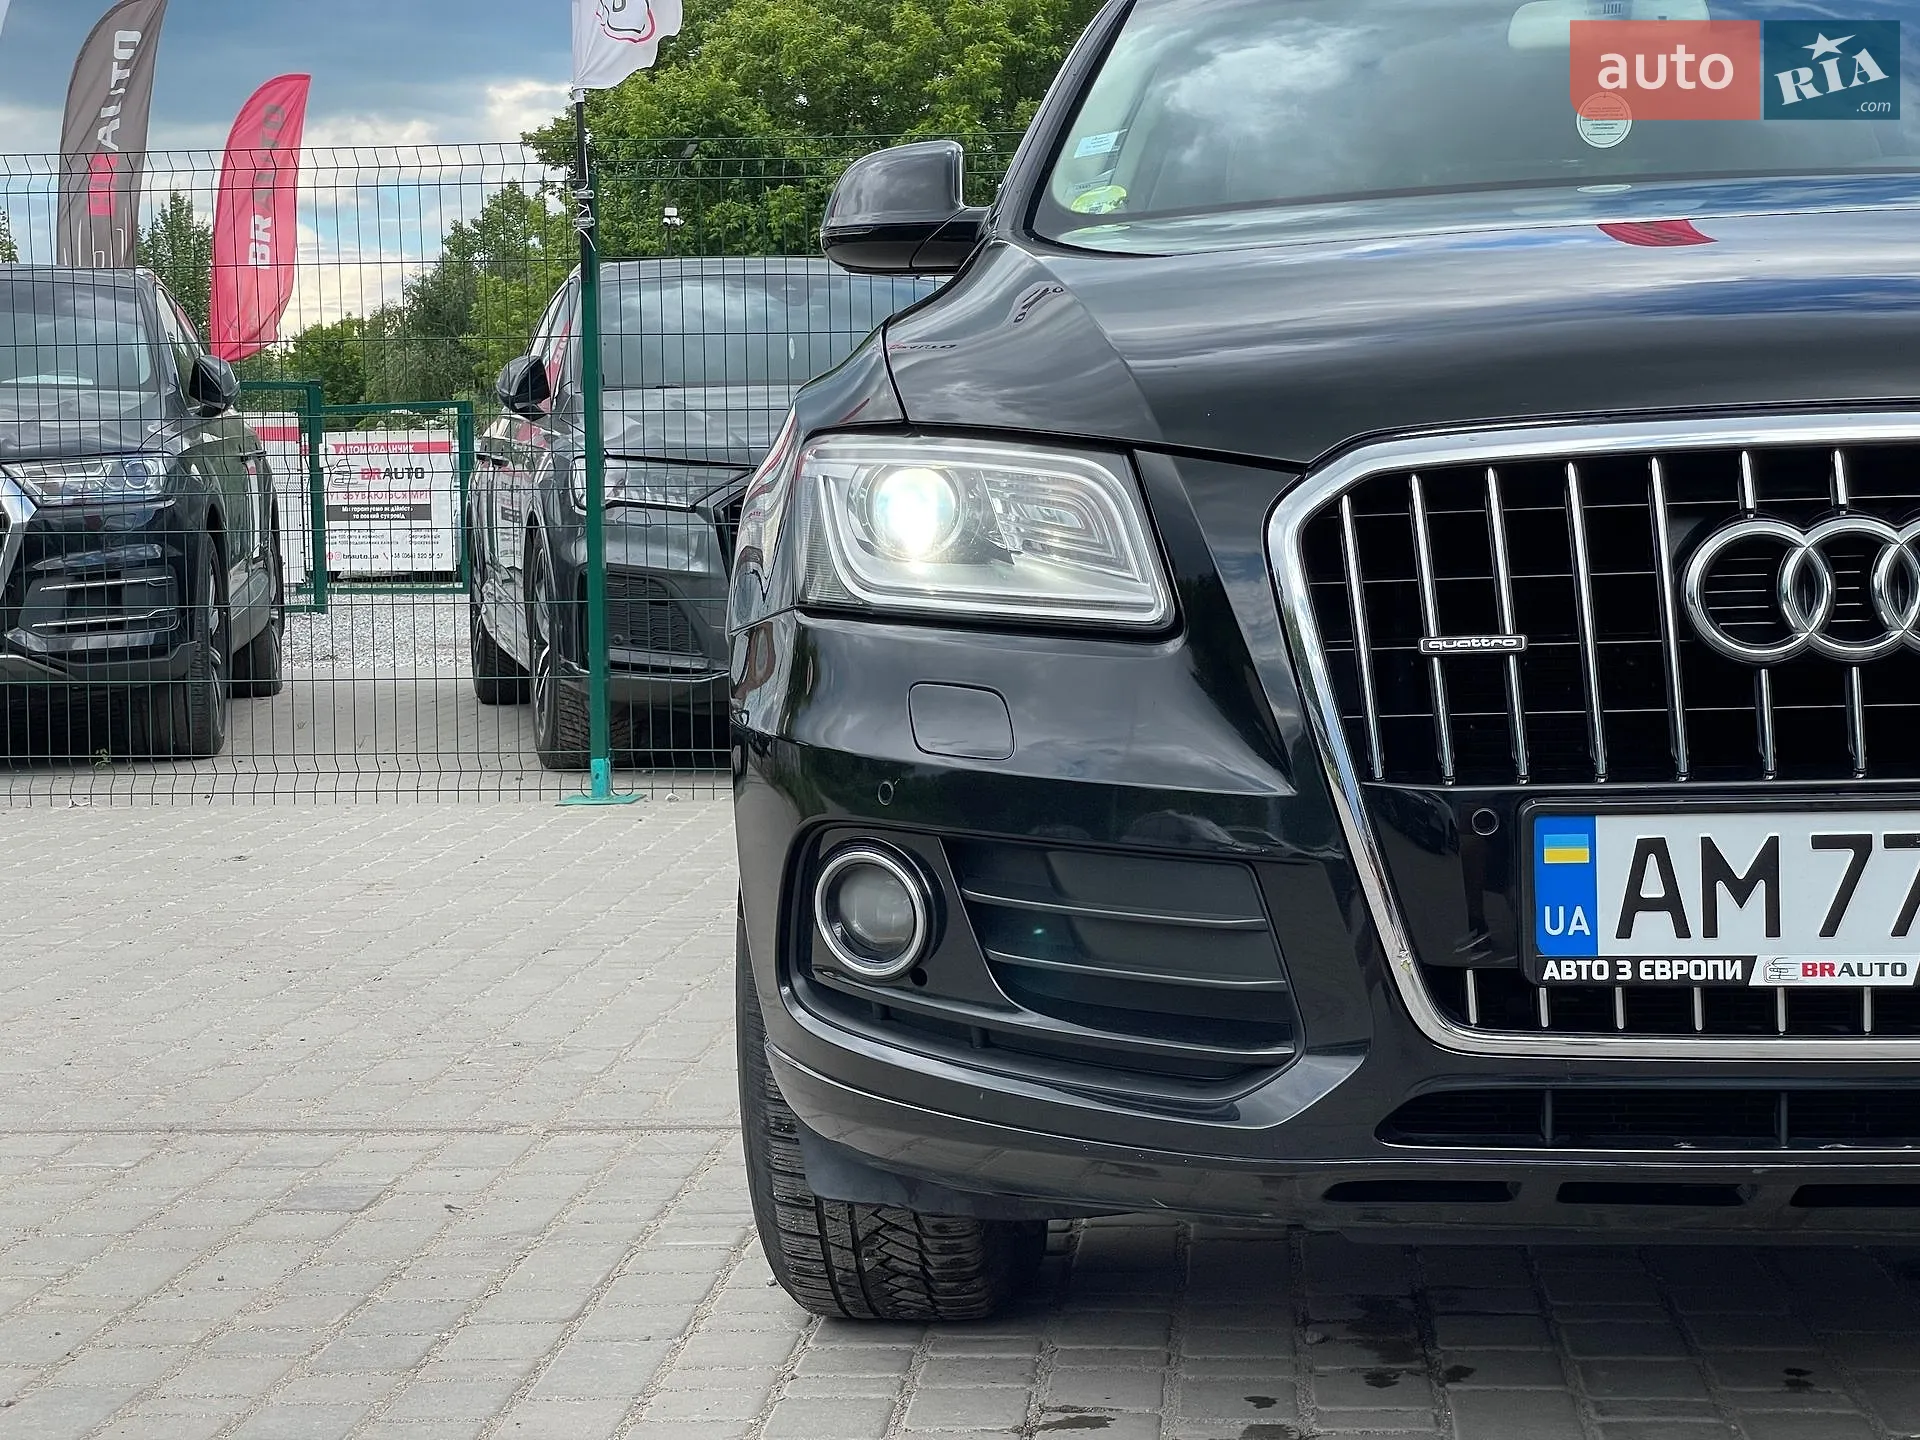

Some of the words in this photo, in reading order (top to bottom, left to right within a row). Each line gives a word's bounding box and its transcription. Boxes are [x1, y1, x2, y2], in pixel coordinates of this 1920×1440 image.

[360, 467, 425, 481] BRAUTO
[1428, 638, 1518, 651] quattro
[1543, 905, 1591, 936] UA
[1614, 834, 1782, 939] AM
[1543, 959, 1610, 981] АВТО
[1615, 959, 1633, 981] З
[1638, 959, 1743, 982] ЄВРОПИ
[1801, 962, 1908, 978] BRAUTO
